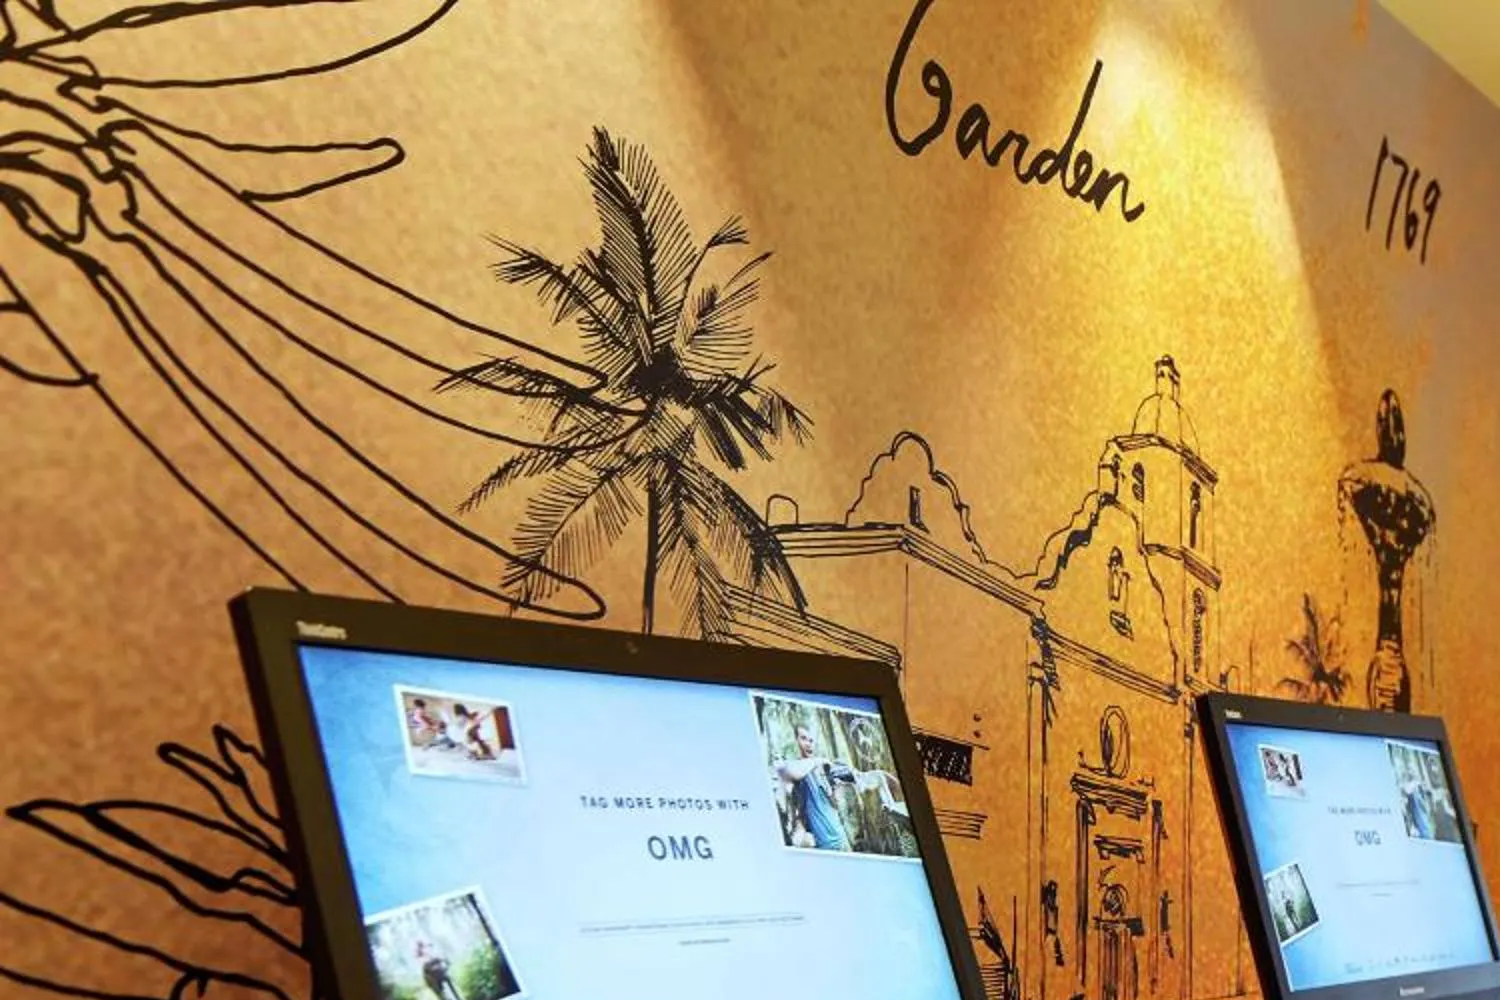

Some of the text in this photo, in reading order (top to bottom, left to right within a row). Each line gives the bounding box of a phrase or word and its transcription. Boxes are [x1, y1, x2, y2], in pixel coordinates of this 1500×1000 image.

[885, 0, 1145, 222] Garden
[1365, 134, 1442, 266] 1769
[580, 795, 749, 811] TAG MORE PHOTOS WITH
[647, 835, 714, 861] OMG
